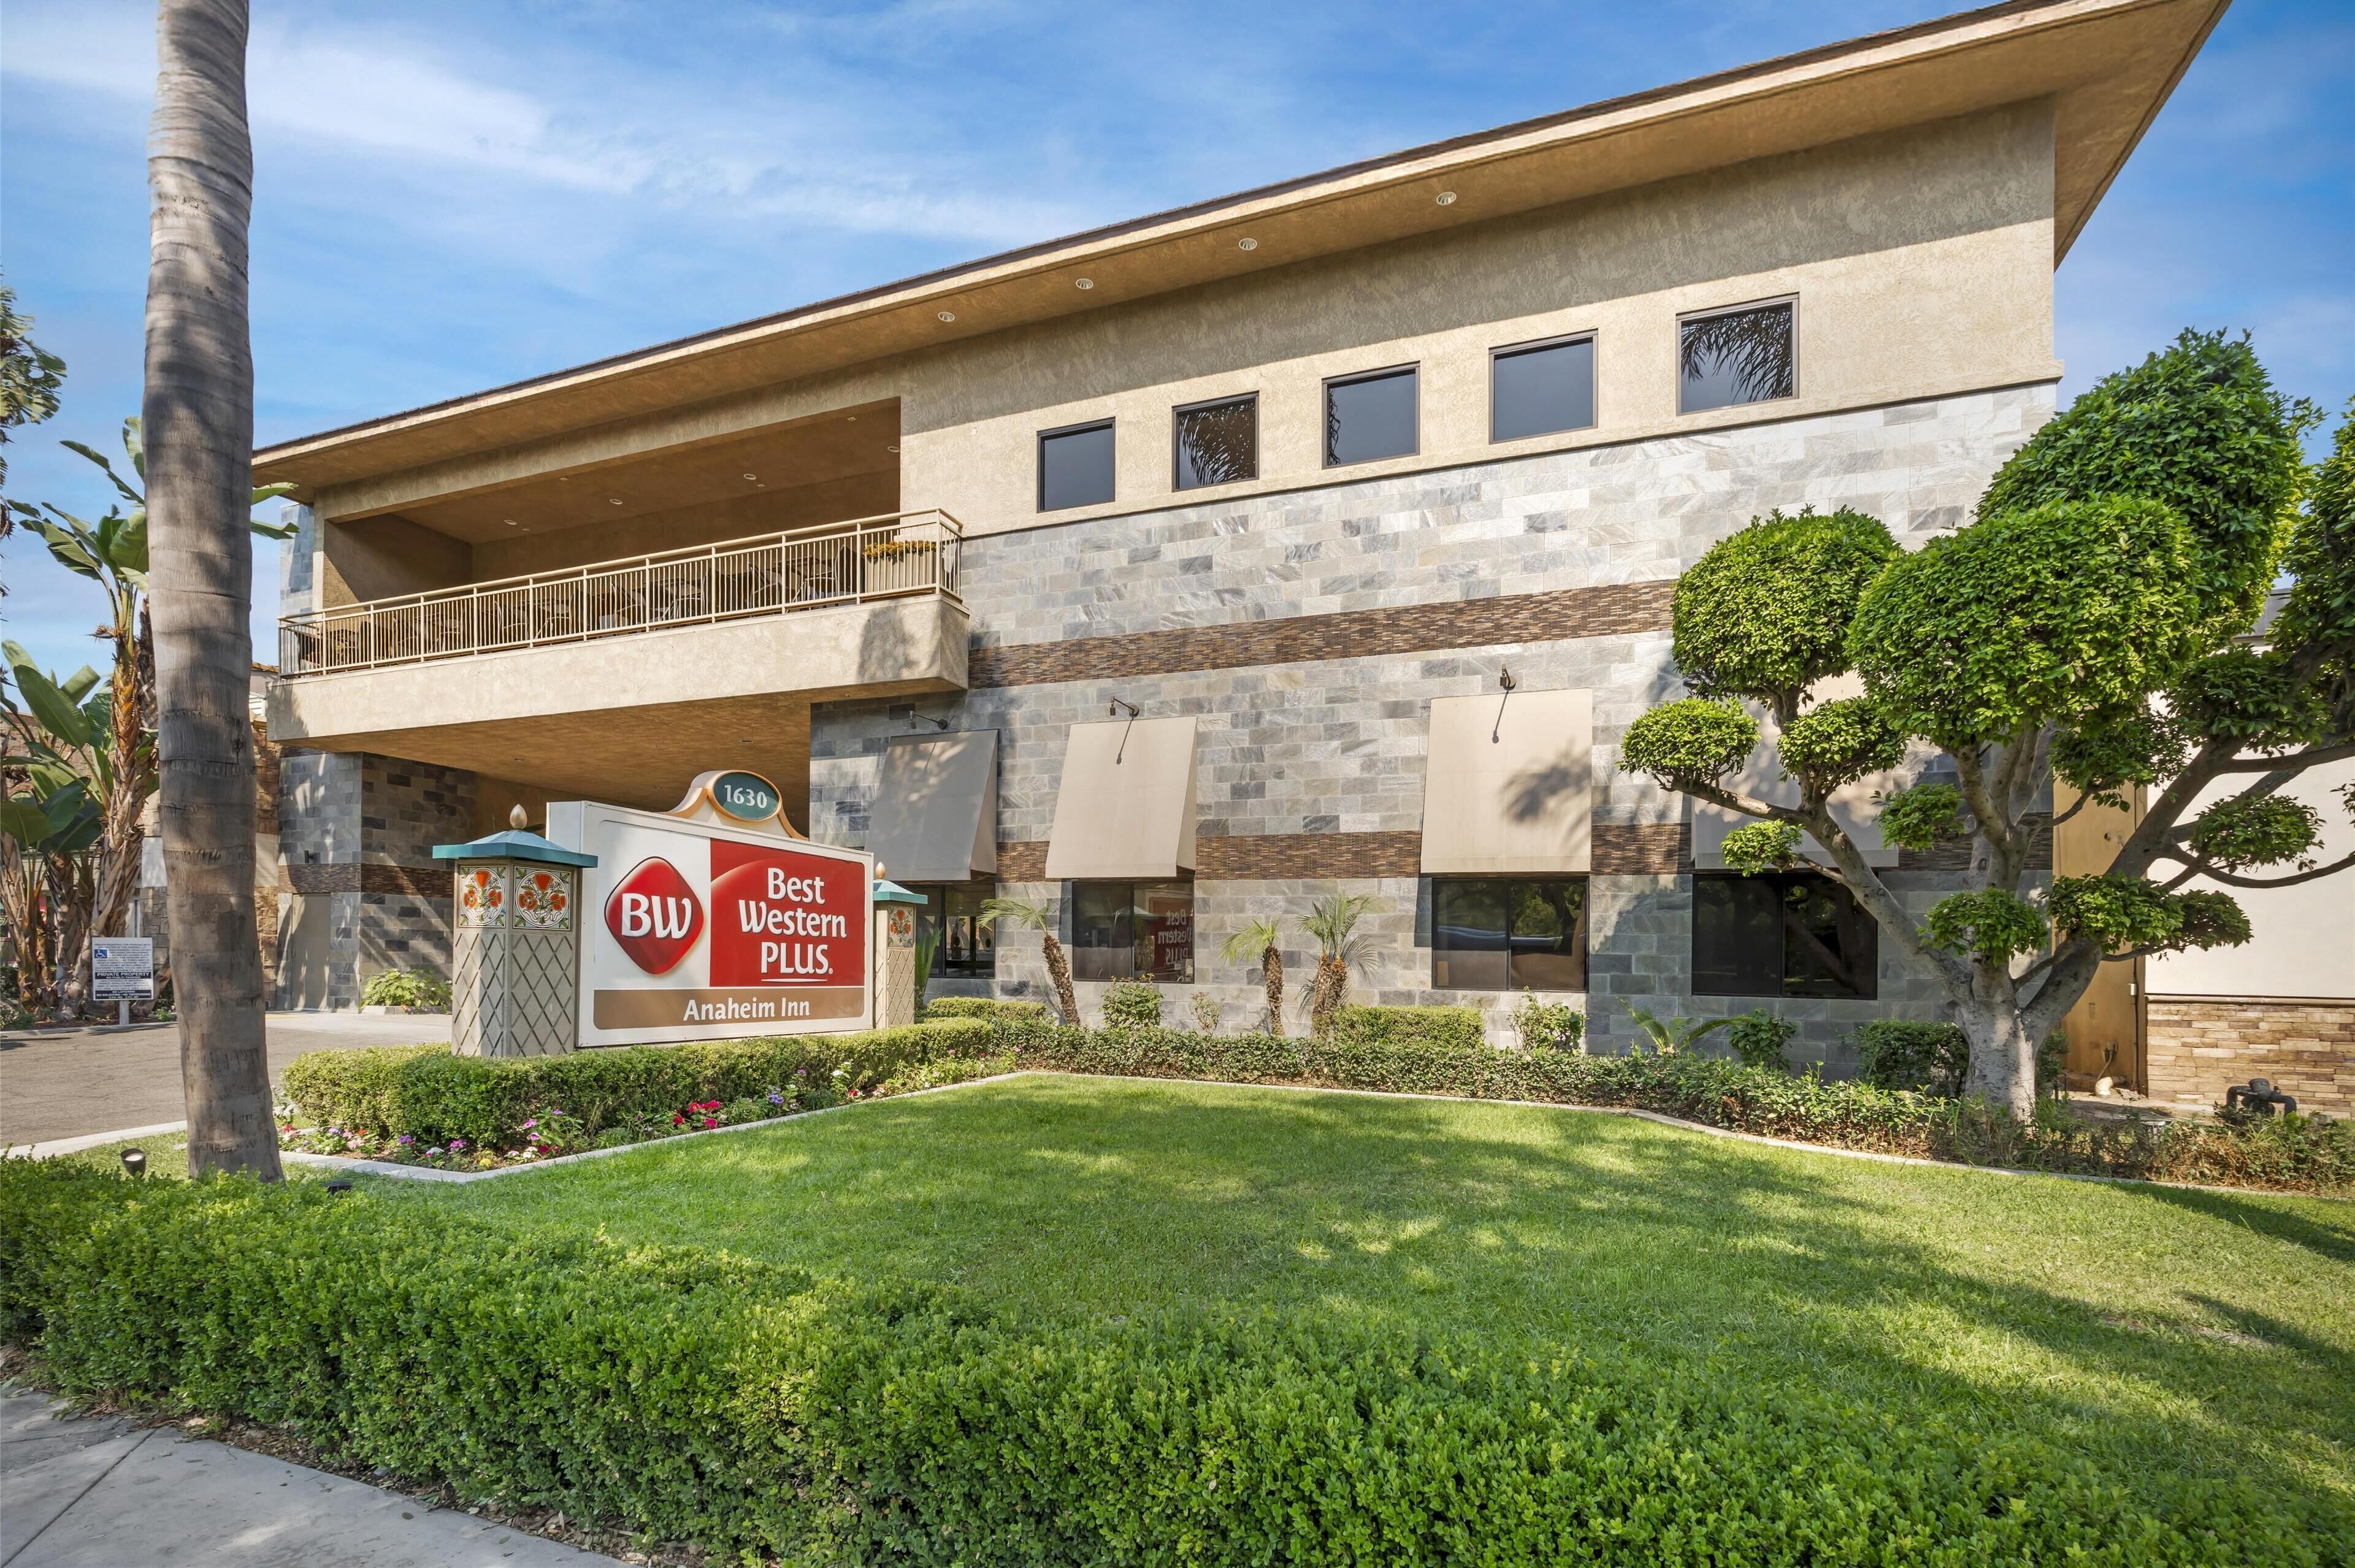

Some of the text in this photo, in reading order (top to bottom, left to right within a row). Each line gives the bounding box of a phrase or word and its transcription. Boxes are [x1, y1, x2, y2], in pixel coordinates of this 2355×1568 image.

[724, 784, 768, 809] 1630
[768, 868, 825, 904] Best
[621, 893, 692, 939] BW
[738, 899, 847, 938] Western
[683, 996, 810, 1021] Anaheim Inn
